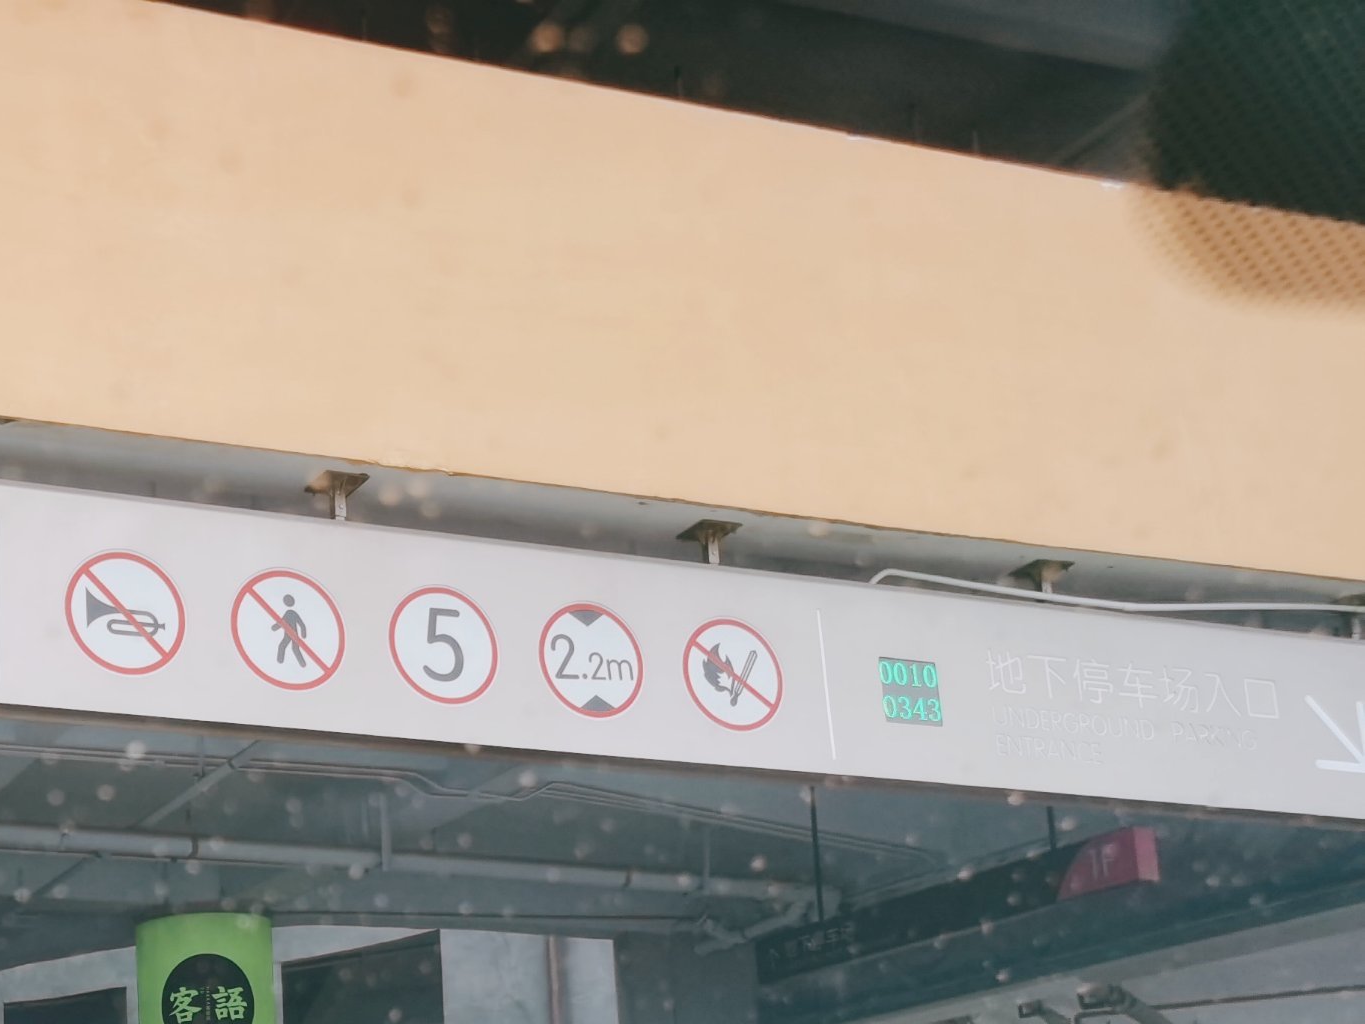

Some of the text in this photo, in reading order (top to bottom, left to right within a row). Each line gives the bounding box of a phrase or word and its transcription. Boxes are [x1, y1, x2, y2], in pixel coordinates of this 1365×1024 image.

[423, 607, 464, 682] 5
[554, 634, 635, 682] 2.2m
[880, 660, 937, 688] 0010
[985, 648, 1281, 720] 地下停车场入口
[883, 695, 941, 722] 0343
[992, 706, 1259, 752] UNDERGROUND PARKING
[994, 733, 1106, 766] ENTRANCE
